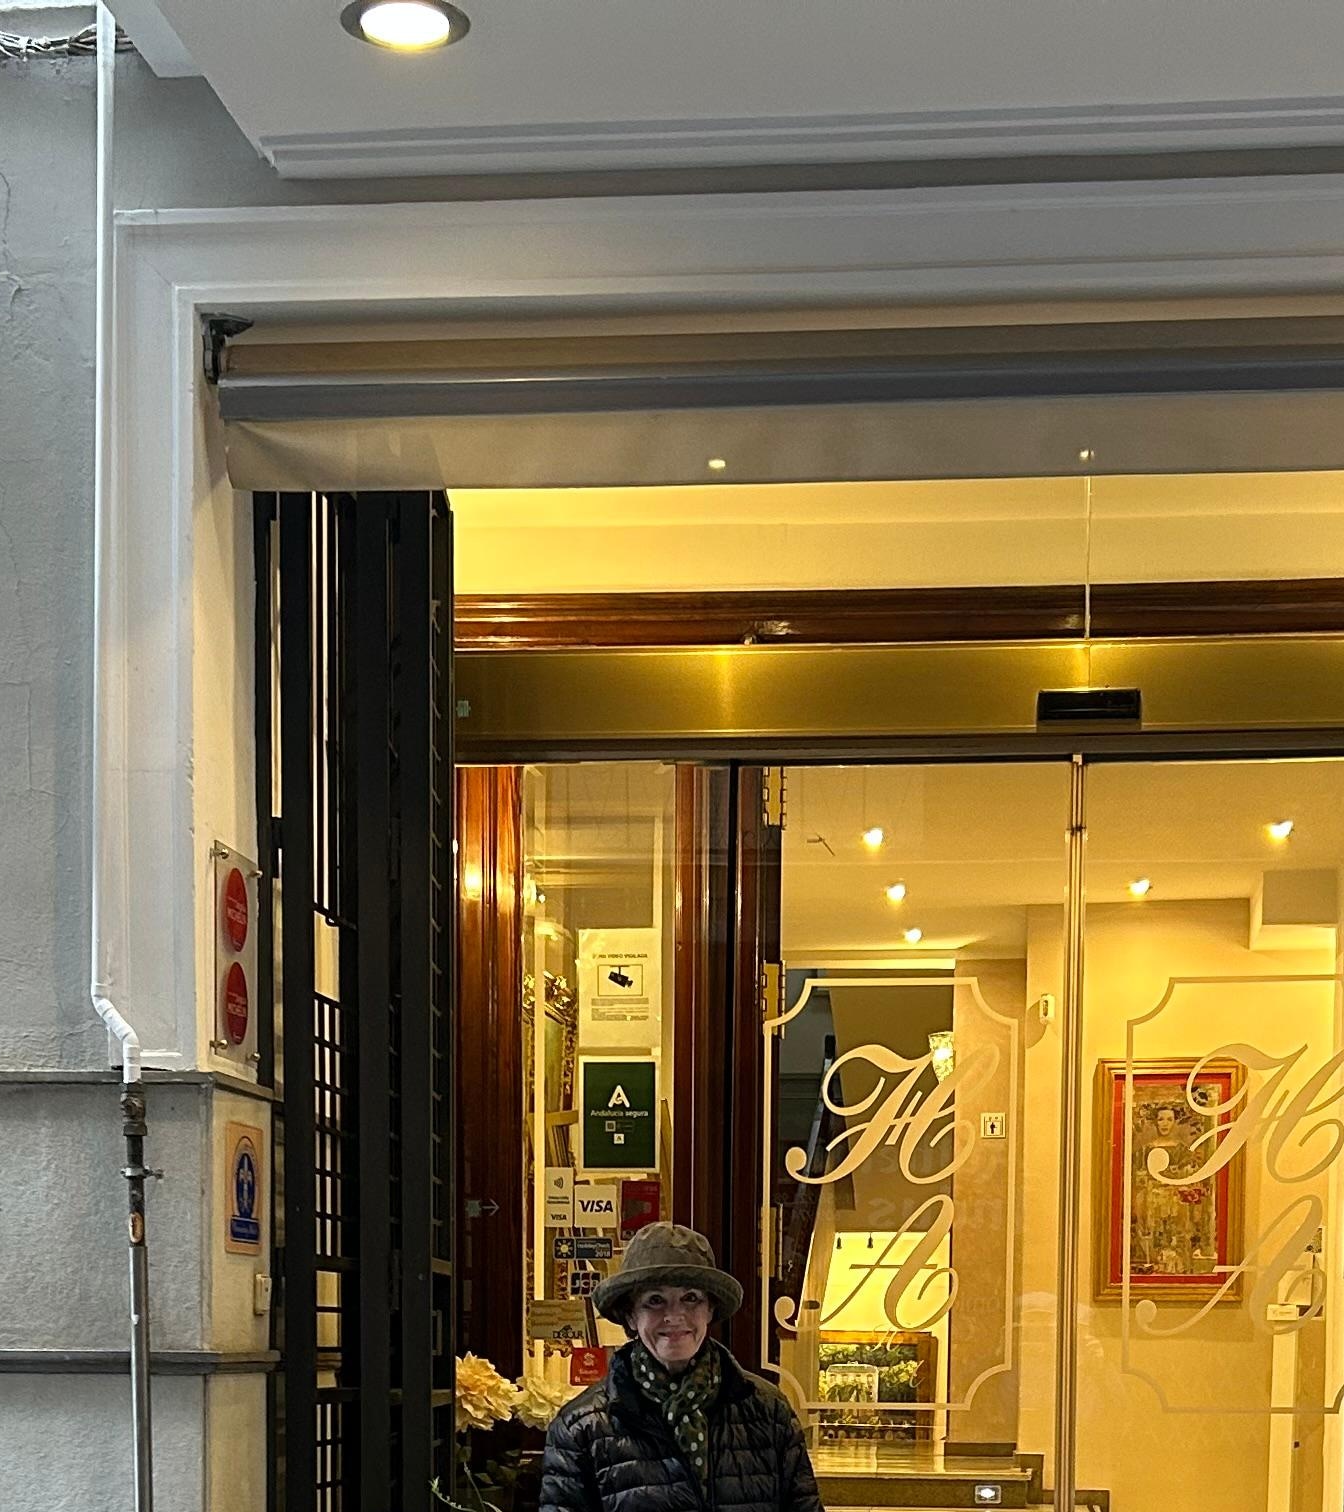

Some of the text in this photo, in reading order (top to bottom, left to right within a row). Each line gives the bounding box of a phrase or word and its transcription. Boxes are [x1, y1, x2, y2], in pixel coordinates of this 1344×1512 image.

[785, 1043, 1001, 1186] H
[550, 1213, 567, 1221] VISA
[579, 1199, 614, 1213] VISA
[775, 1193, 959, 1333] A
[1135, 1193, 1328, 1337] A
